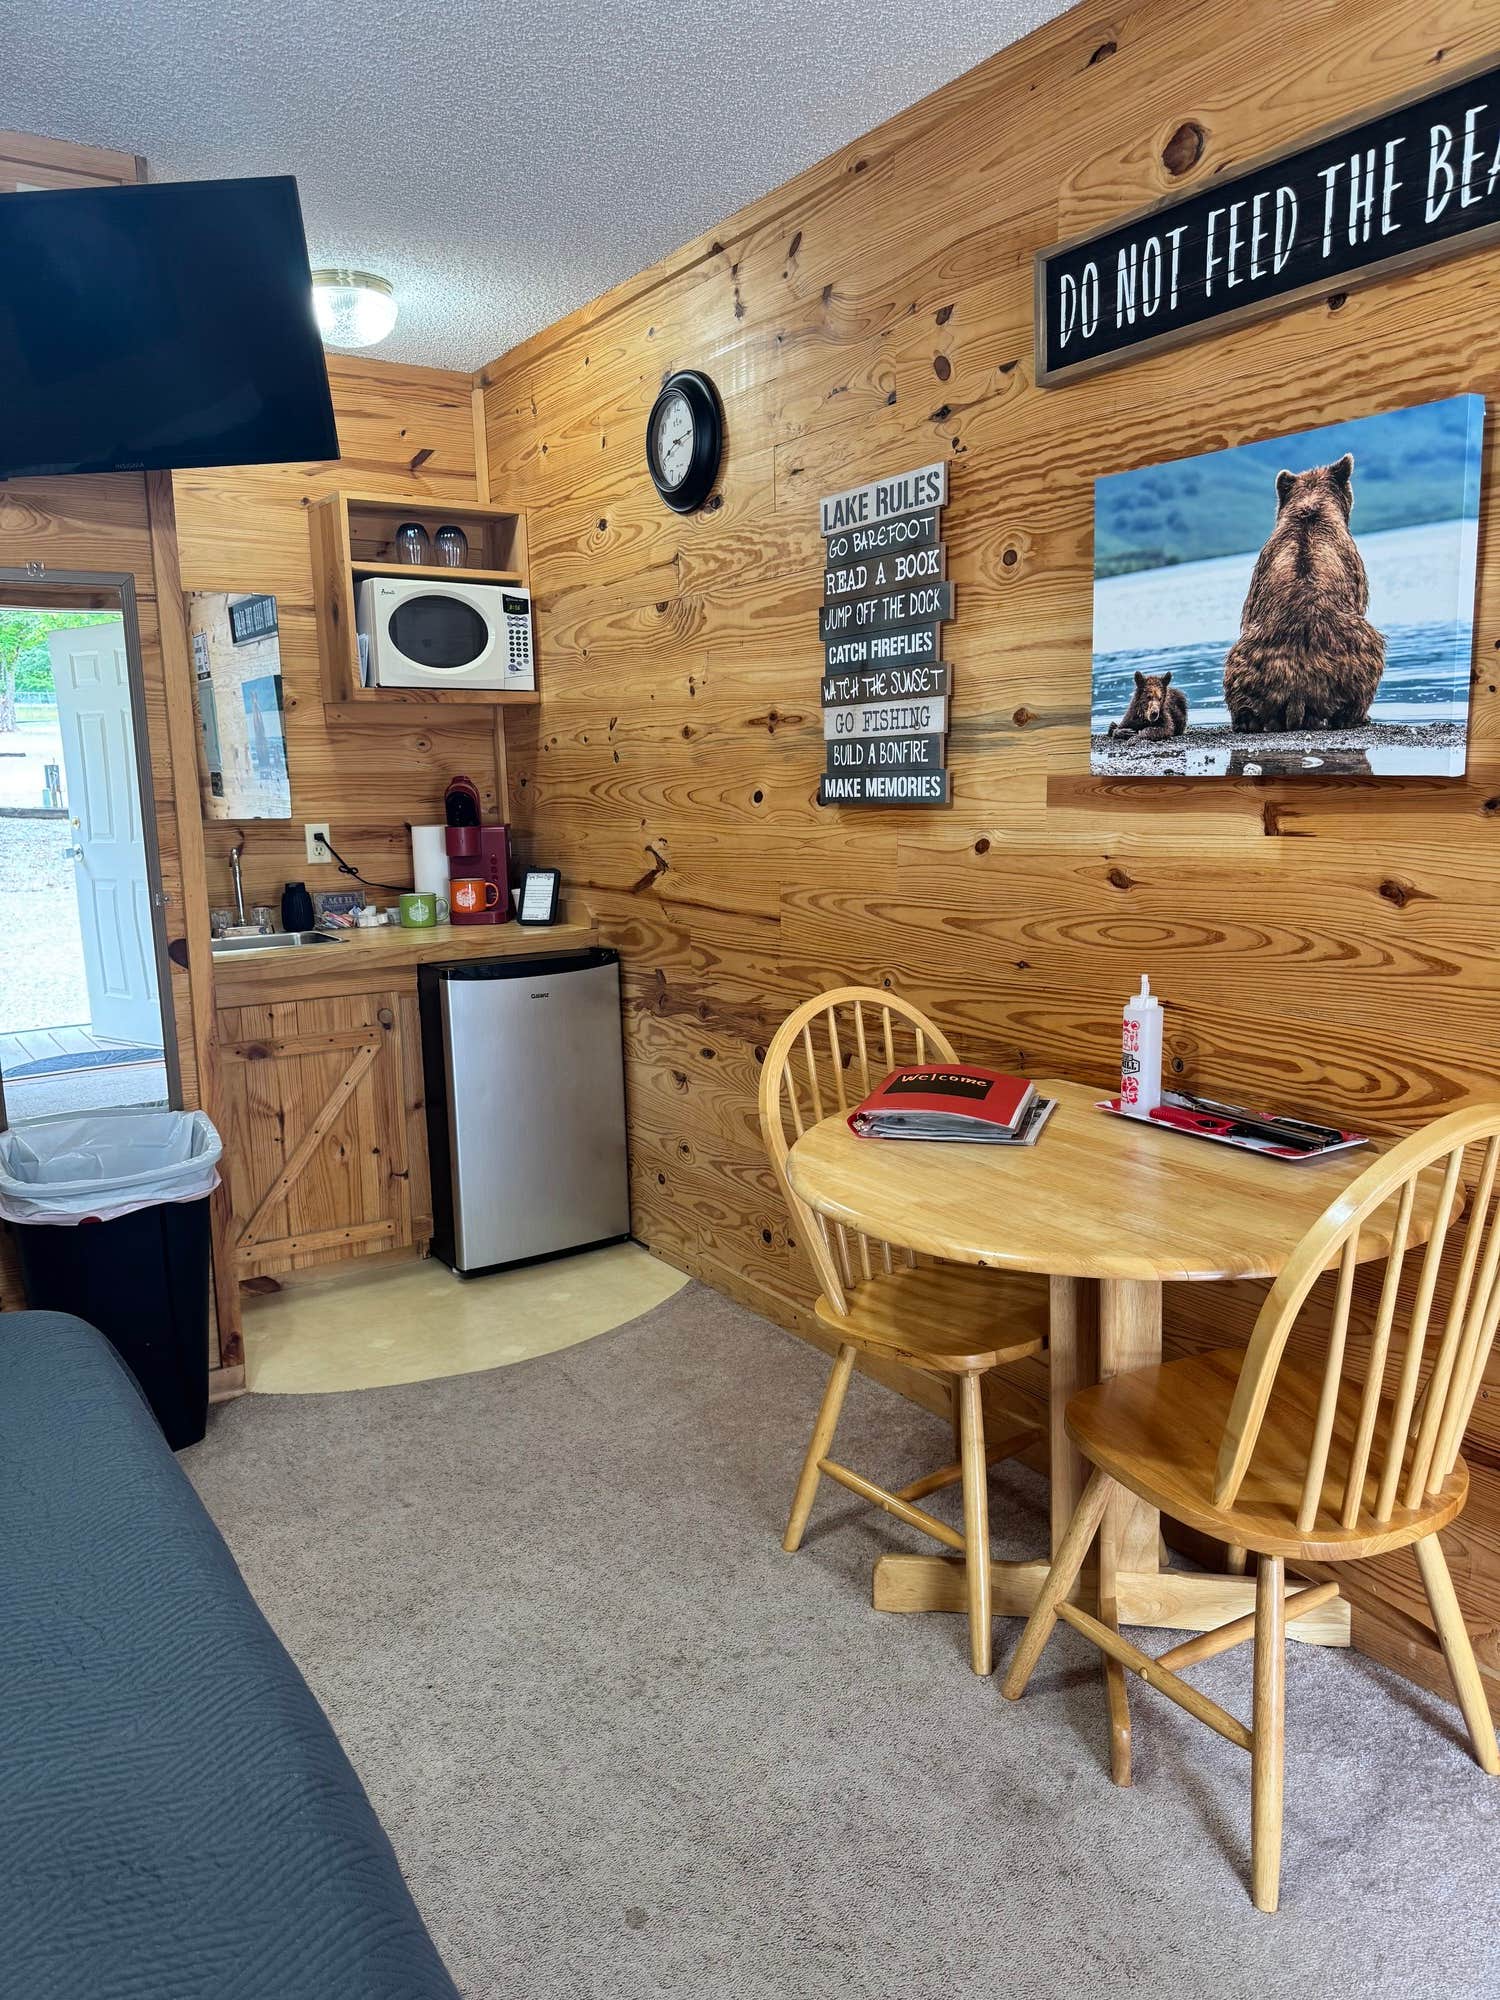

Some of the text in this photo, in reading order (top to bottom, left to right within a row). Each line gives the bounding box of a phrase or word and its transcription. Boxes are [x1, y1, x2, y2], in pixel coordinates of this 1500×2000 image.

[1060, 262, 1099, 348] DO
[1116, 225, 1189, 329] NOT
[1206, 186, 1298, 297] FEED
[1317, 137, 1406, 258] THE
[824, 471, 940, 531] LAKE RULES
[829, 516, 935, 558] GO BAREFOOT
[826, 550, 940, 595] READ A BOOK
[825, 588, 941, 631] JUMP OFF THE DOCK
[829, 631, 933, 665] CATCH FIREFLIES
[823, 667, 944, 701] WATCH THE SUNSET
[835, 705, 931, 734] GO FISHING
[834, 740, 929, 766] BUILD A BONFIRE
[825, 775, 941, 798] MAKE MEMORIES
[901, 1073, 989, 1088] Welcome
